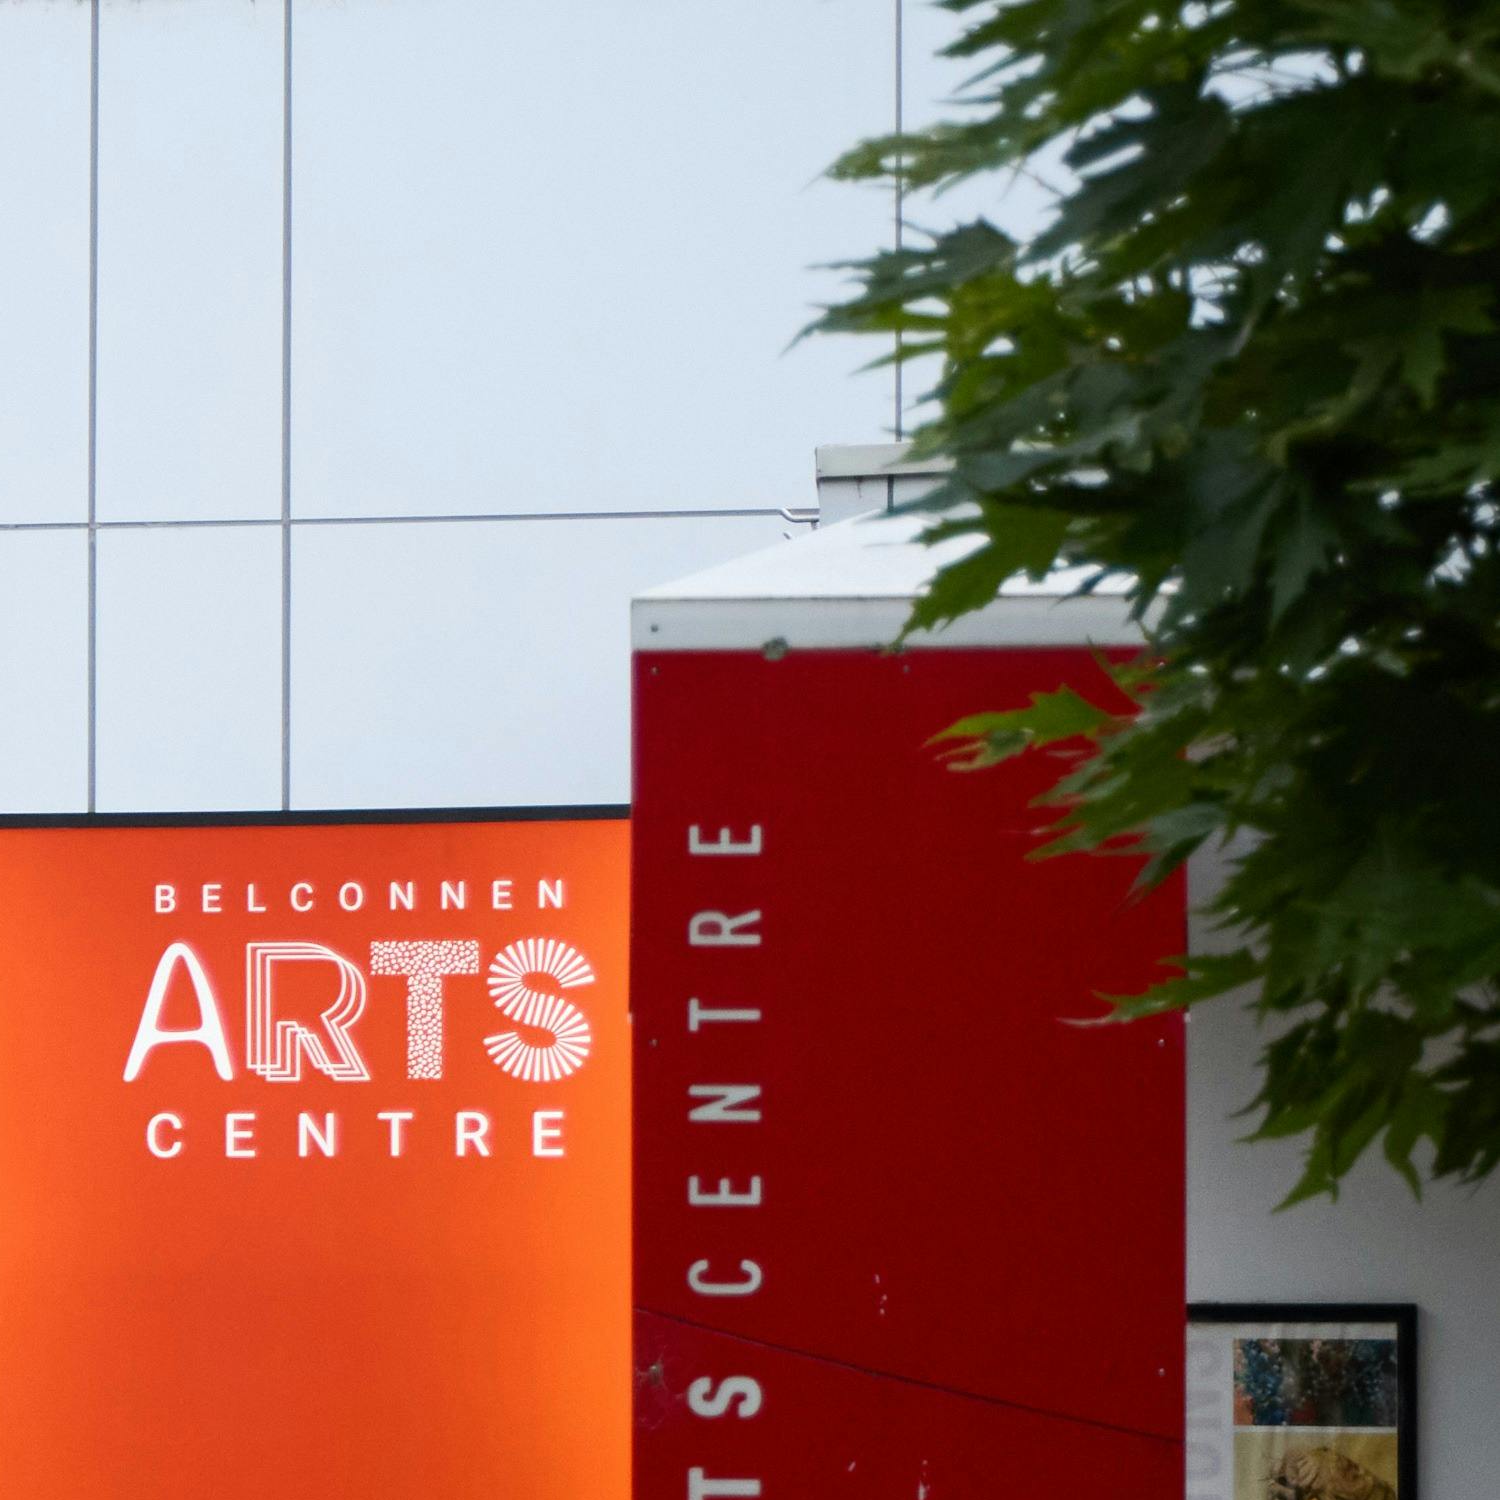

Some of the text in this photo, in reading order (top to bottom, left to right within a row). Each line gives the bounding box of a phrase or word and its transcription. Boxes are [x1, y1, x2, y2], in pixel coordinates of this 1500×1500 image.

[154, 879, 566, 915] BELCONNEN
[123, 938, 596, 1083] ARTS
[688, 823, 763, 1298] CENTRE
[146, 1110, 567, 1160] CENTRE
